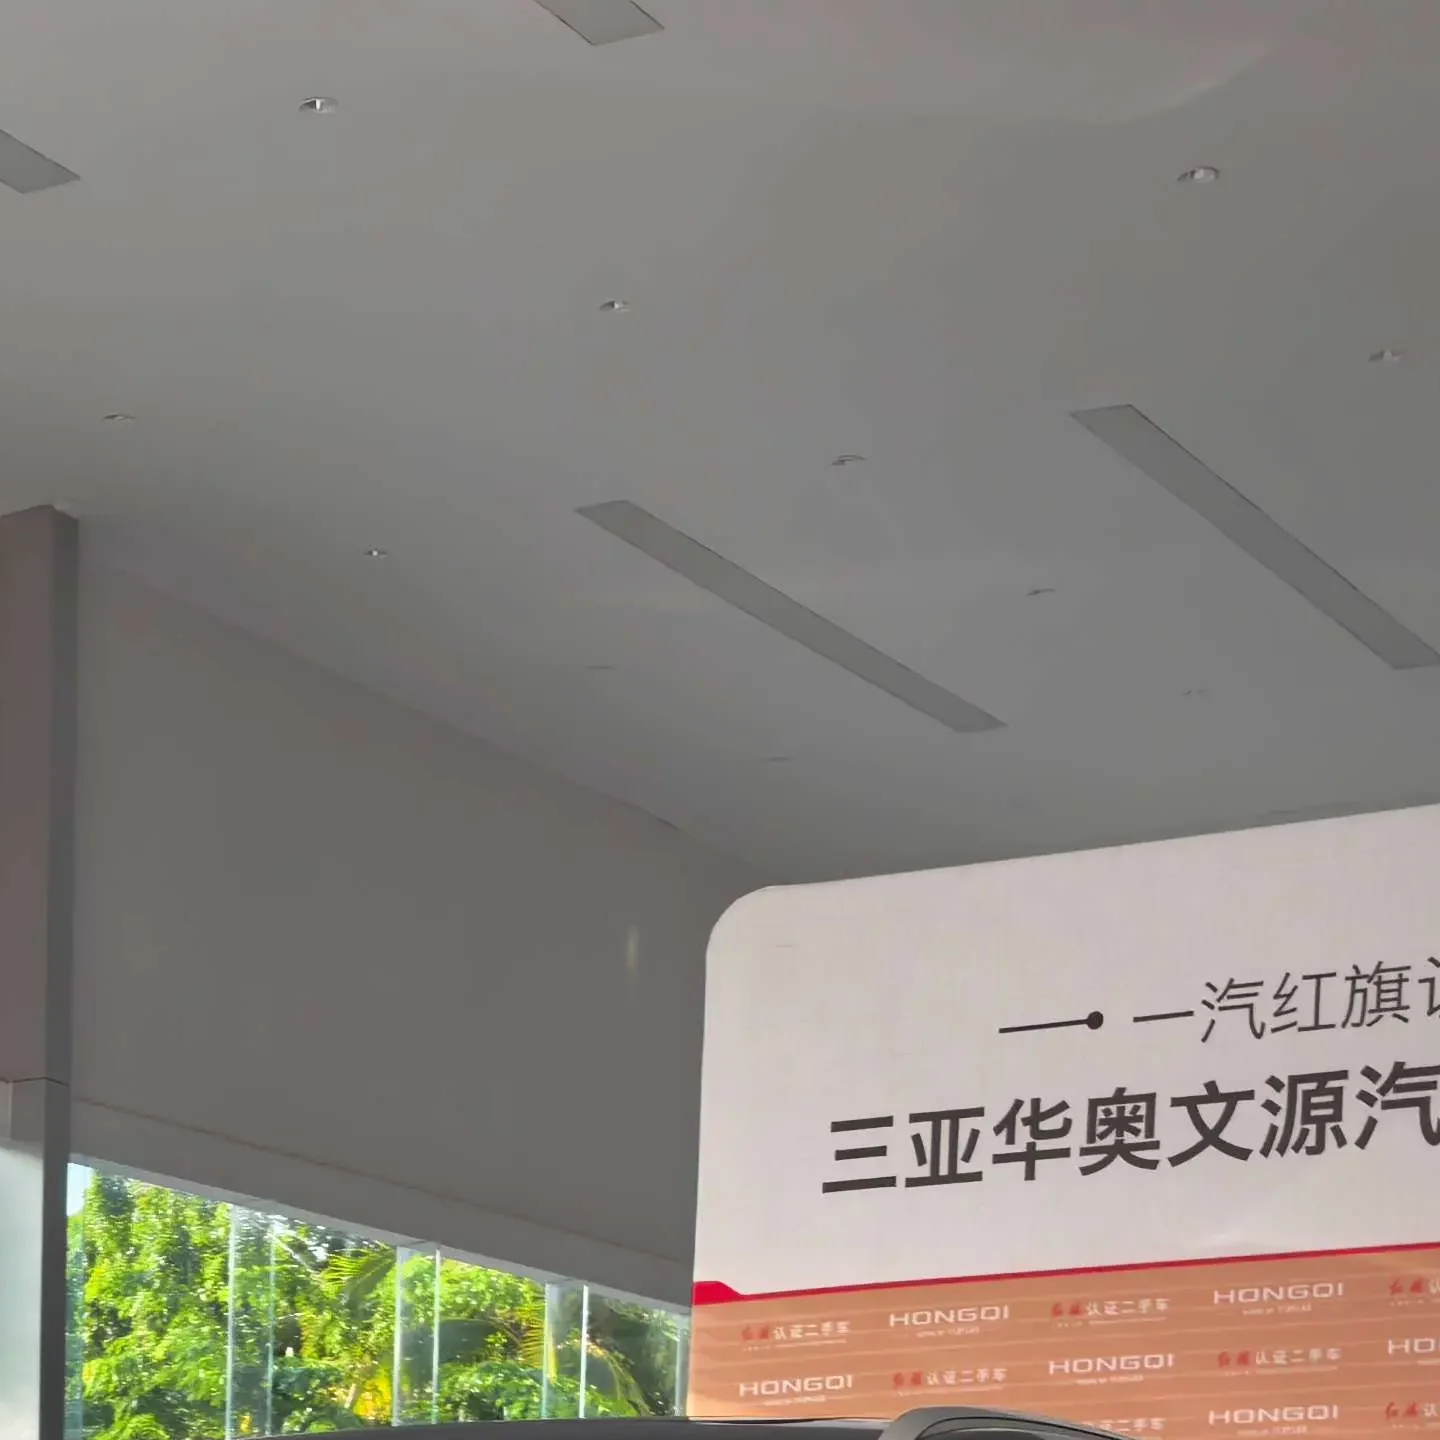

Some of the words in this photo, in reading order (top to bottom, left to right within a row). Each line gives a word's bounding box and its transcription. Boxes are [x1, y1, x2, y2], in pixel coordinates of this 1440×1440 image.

[1213, 1282, 1344, 1305] HONGQI
[889, 1304, 1010, 1328] HONGQI
[1048, 1352, 1175, 1376] HONGQI
[739, 1373, 854, 1397] HONGQI
[1208, 1404, 1339, 1426] HONGQI
